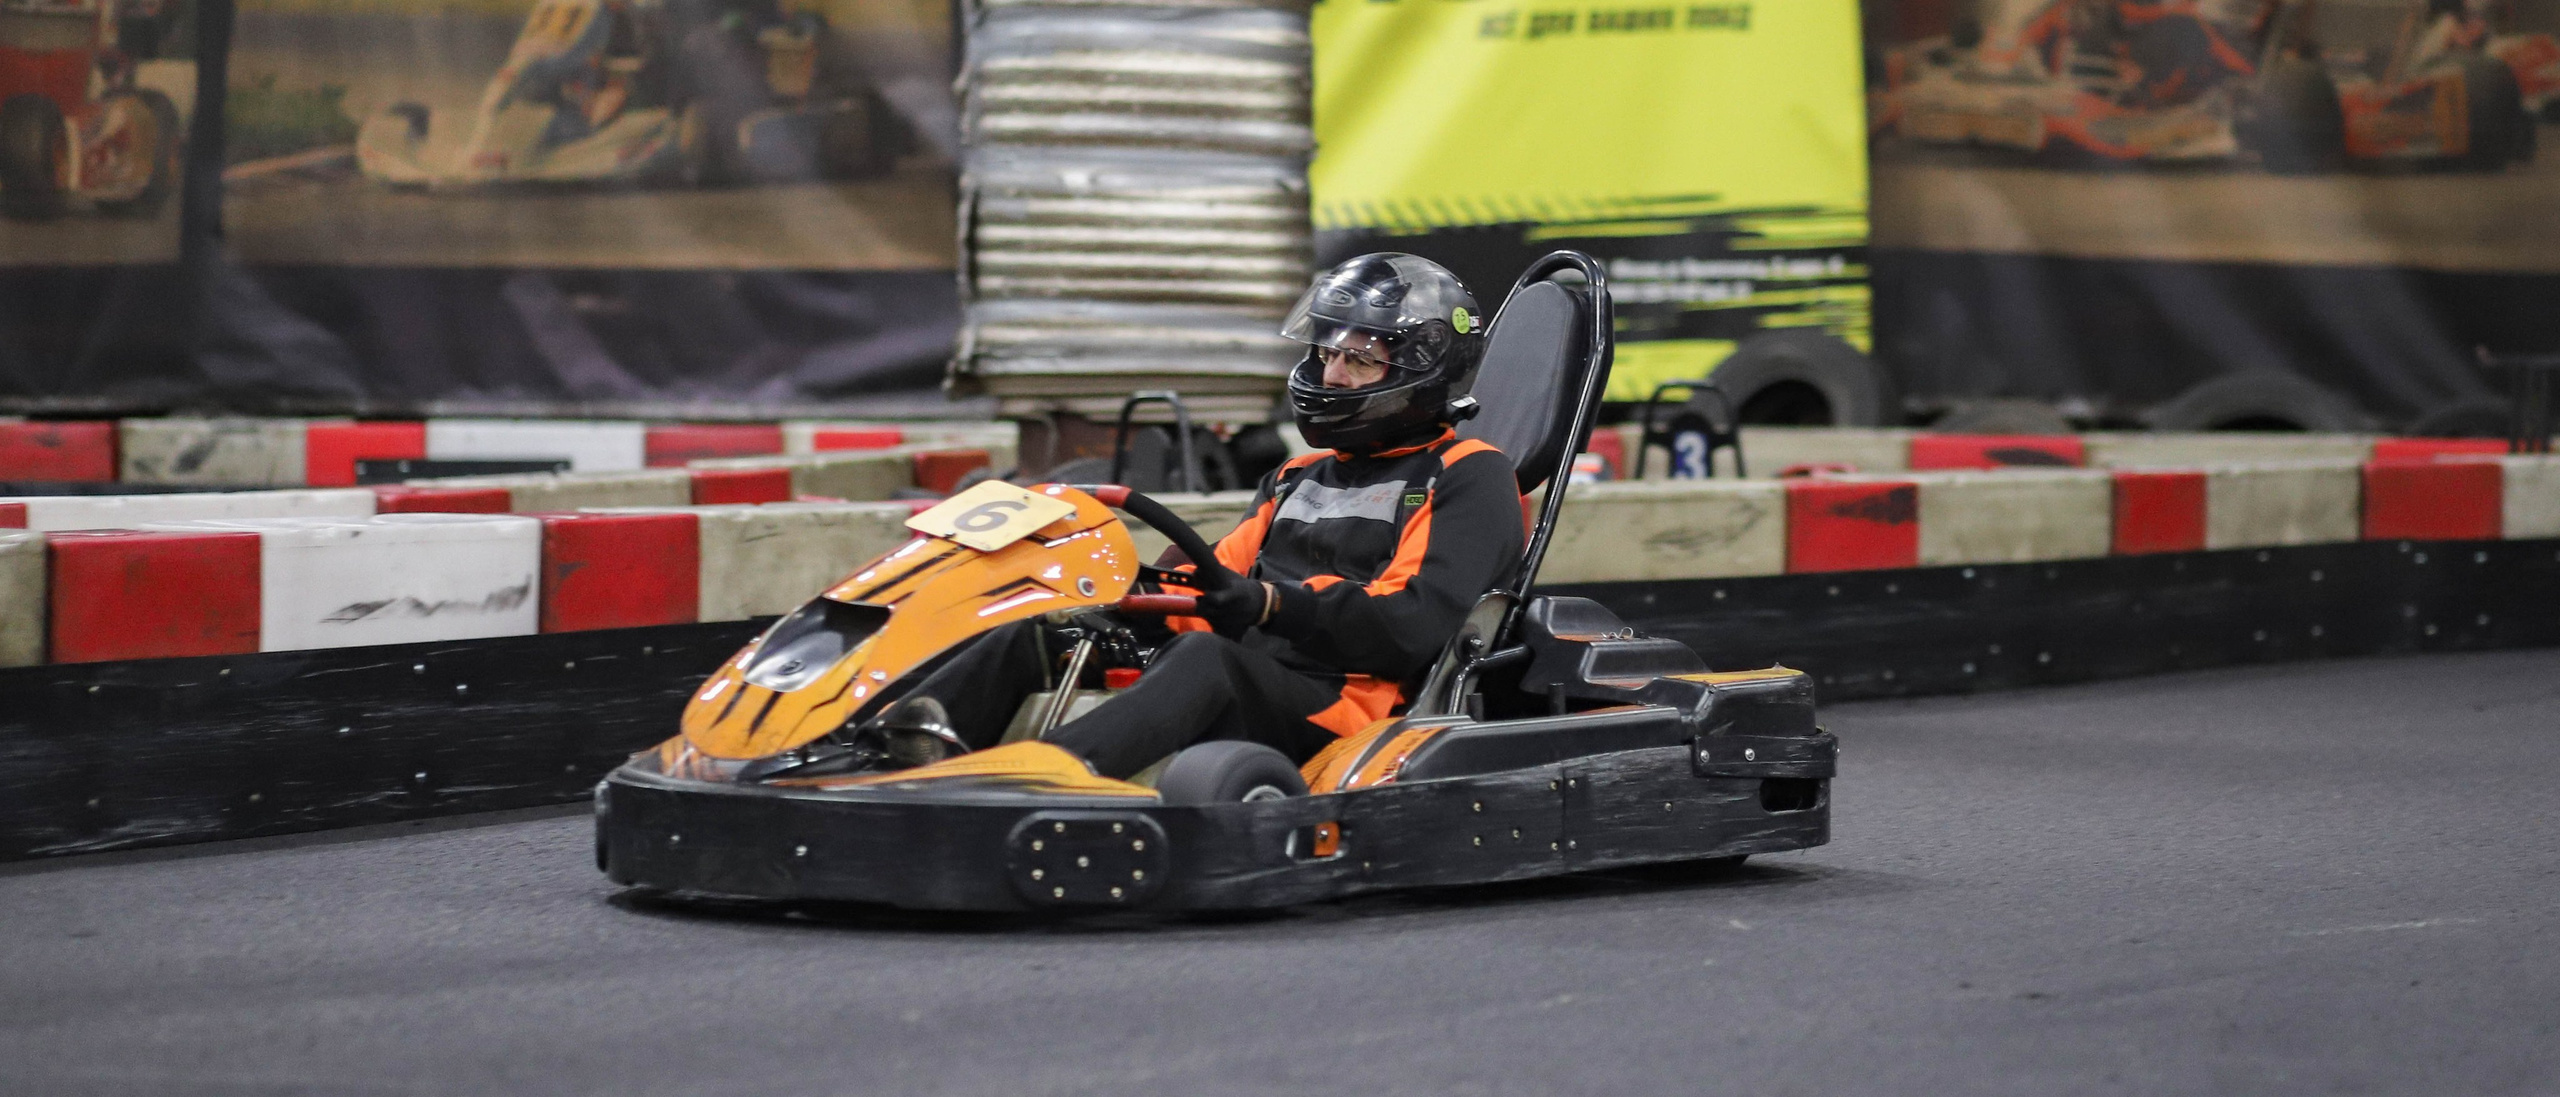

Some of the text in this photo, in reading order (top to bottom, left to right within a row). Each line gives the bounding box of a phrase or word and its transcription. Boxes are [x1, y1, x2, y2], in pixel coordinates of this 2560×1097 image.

[1674, 431, 1708, 480] 3
[953, 500, 1029, 533] 6
[1291, 492, 1324, 510] CING
